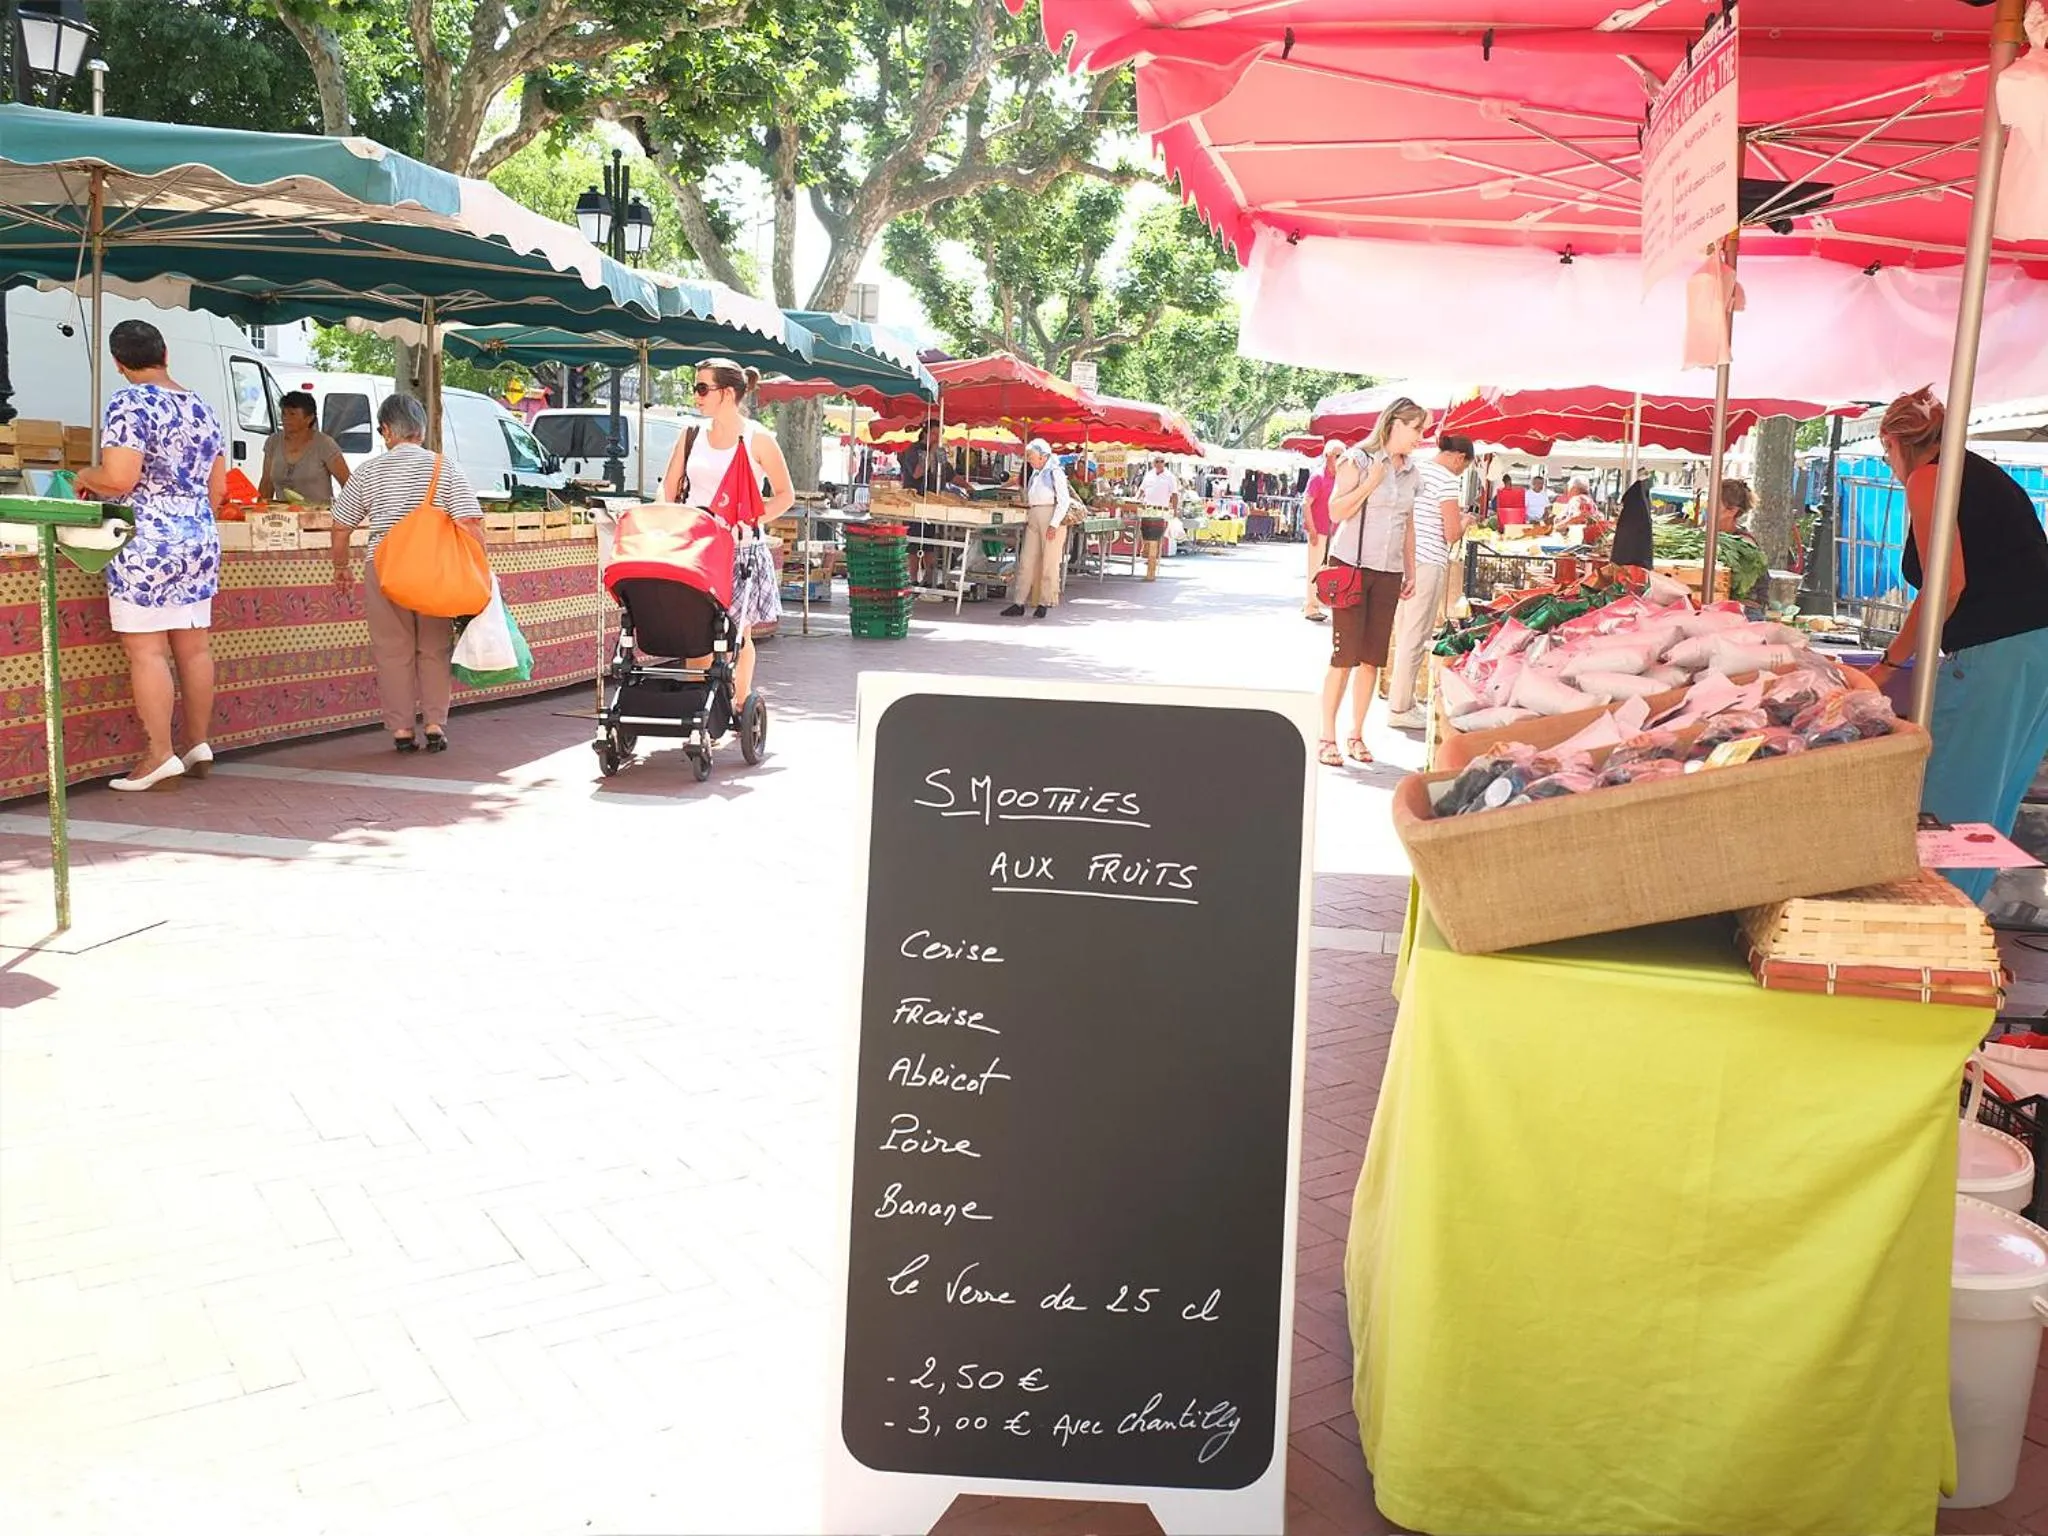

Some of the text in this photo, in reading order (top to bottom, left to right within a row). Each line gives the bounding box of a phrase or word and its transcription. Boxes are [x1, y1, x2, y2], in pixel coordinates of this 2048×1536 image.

[990, 852, 1054, 883] AUX
[901, 930, 1004, 962] Cerise
[880, 1114, 981, 1157] Poire
[875, 1183, 993, 1225] Banane
[947, 1262, 1016, 1304] Verre
[1040, 1283, 1087, 1310] de
[1106, 1285, 1160, 1312] 25
[1182, 1291, 1220, 1321] cl
[910, 1357, 1004, 1394] 2,50
[1018, 1368, 1049, 1391] €
[1004, 1416, 1030, 1435] €
